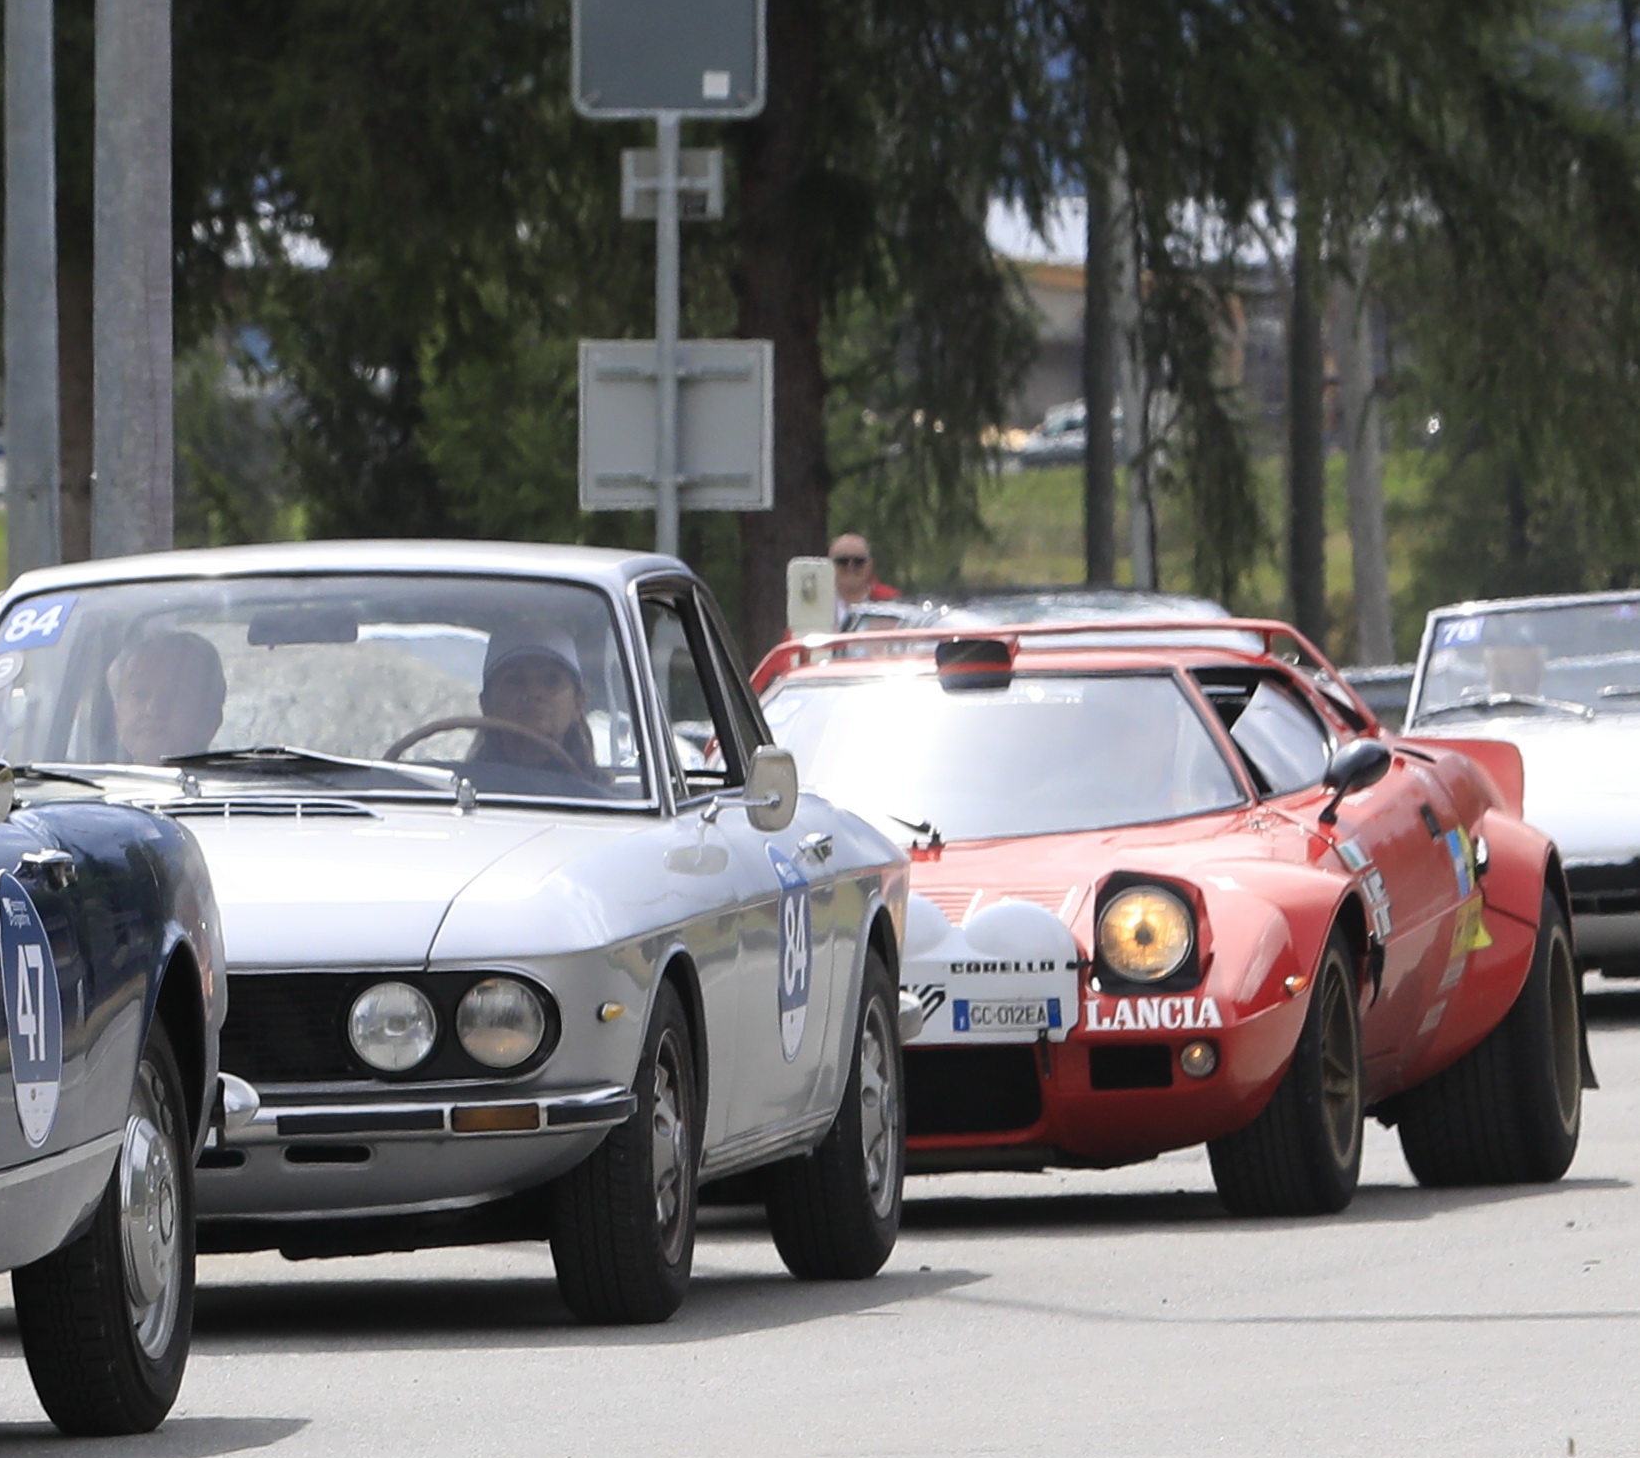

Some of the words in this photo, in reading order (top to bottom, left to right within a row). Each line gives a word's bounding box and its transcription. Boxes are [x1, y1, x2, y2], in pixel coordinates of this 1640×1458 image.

[4, 604, 63, 642] 84
[784, 894, 808, 997] 84
[17, 944, 46, 1062] 47
[1084, 996, 1223, 1032] LANCIA
